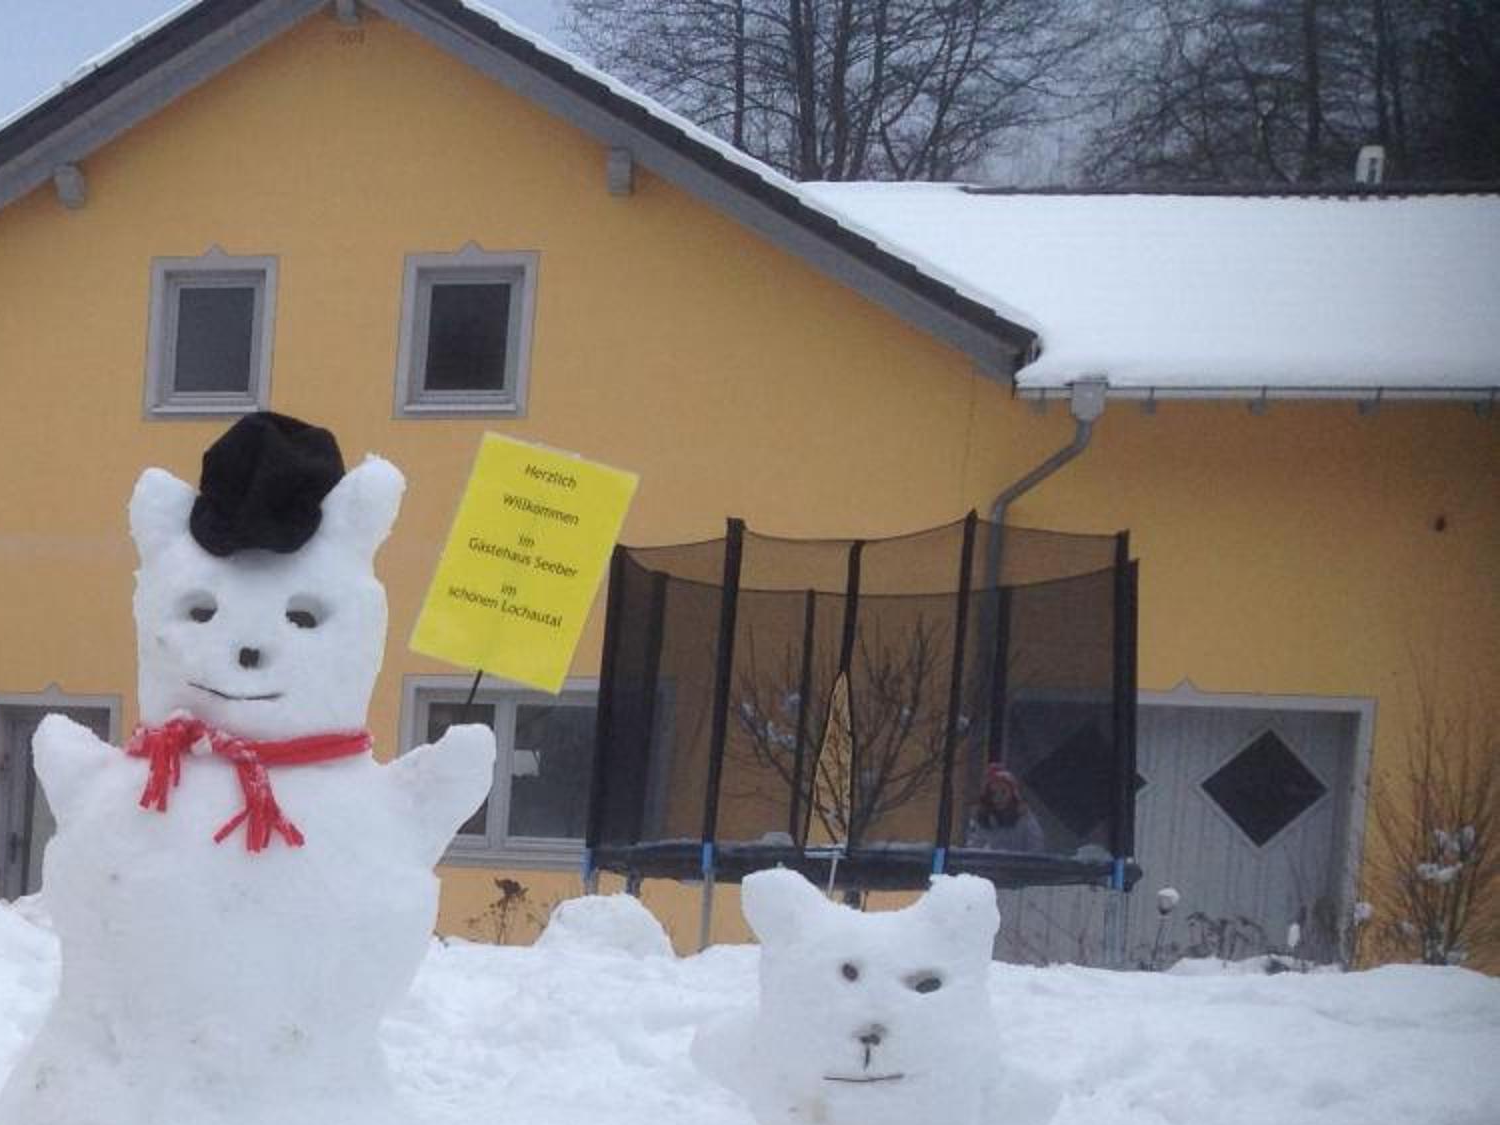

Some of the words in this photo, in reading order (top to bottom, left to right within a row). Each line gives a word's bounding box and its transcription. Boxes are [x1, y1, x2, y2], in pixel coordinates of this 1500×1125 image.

[524, 464, 577, 488] Herzlich
[503, 493, 580, 526] Willkommen
[533, 555, 579, 577] Seeber
[500, 599, 563, 628] Lochautal
